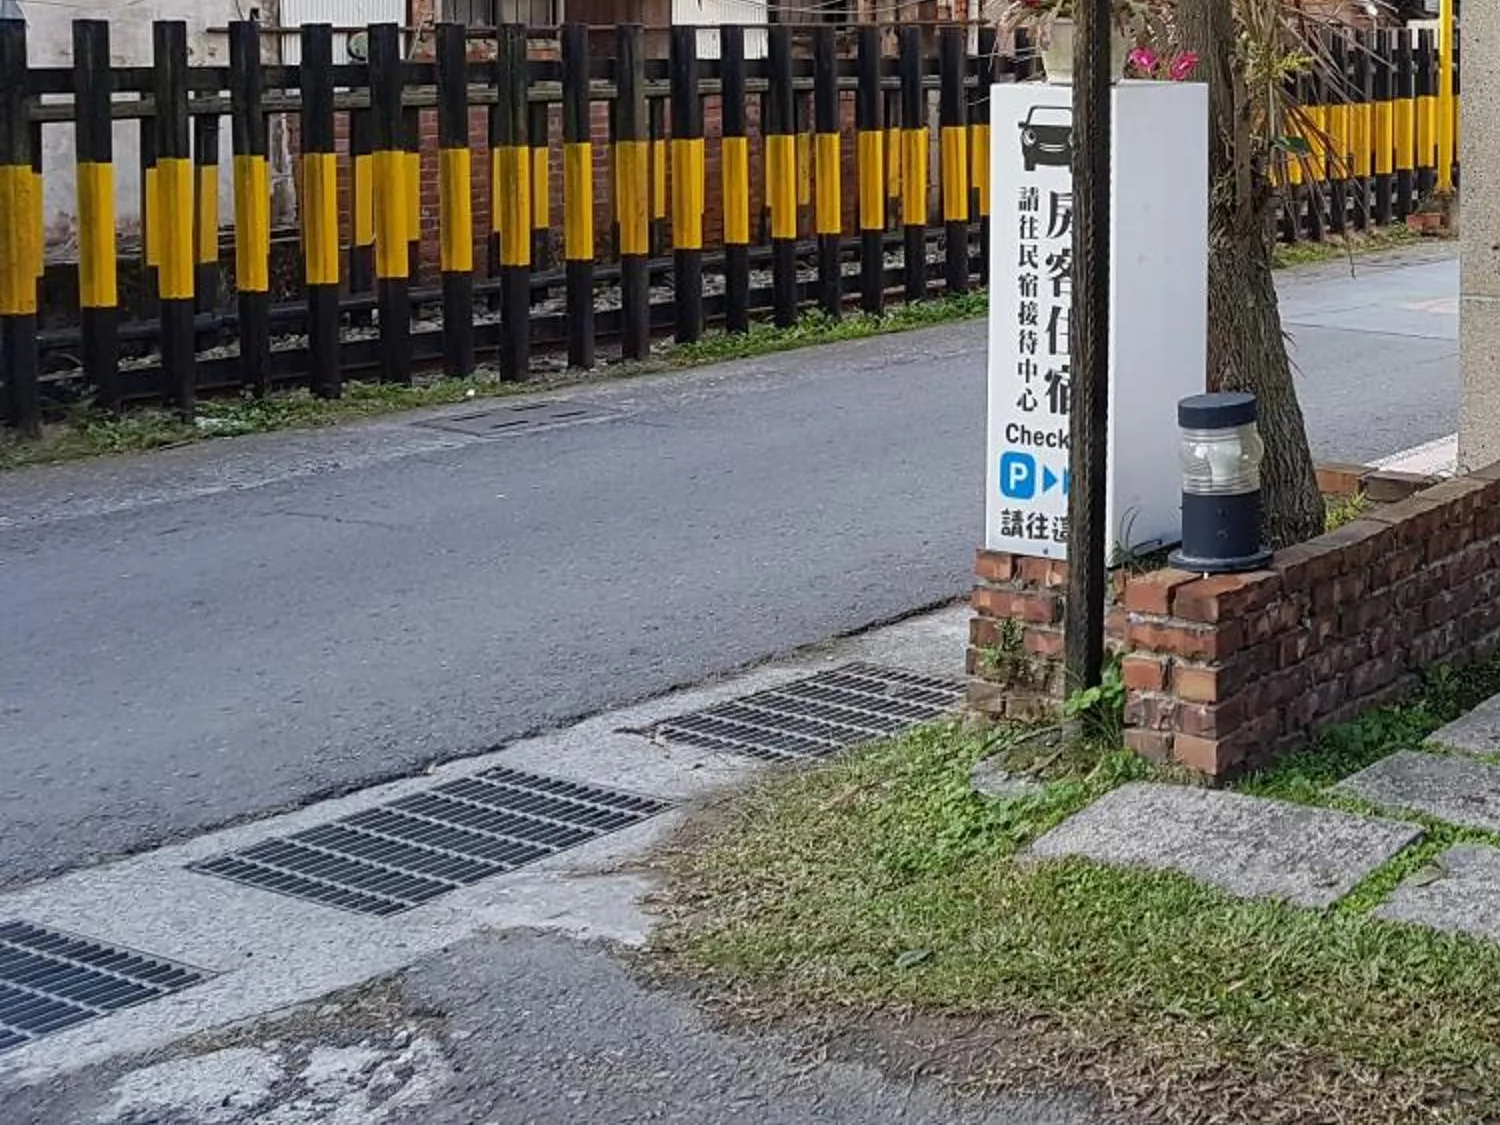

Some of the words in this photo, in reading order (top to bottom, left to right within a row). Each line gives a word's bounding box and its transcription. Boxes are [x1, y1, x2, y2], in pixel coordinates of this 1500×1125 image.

[1016, 186, 1039, 412] 請往民宿接待中心
